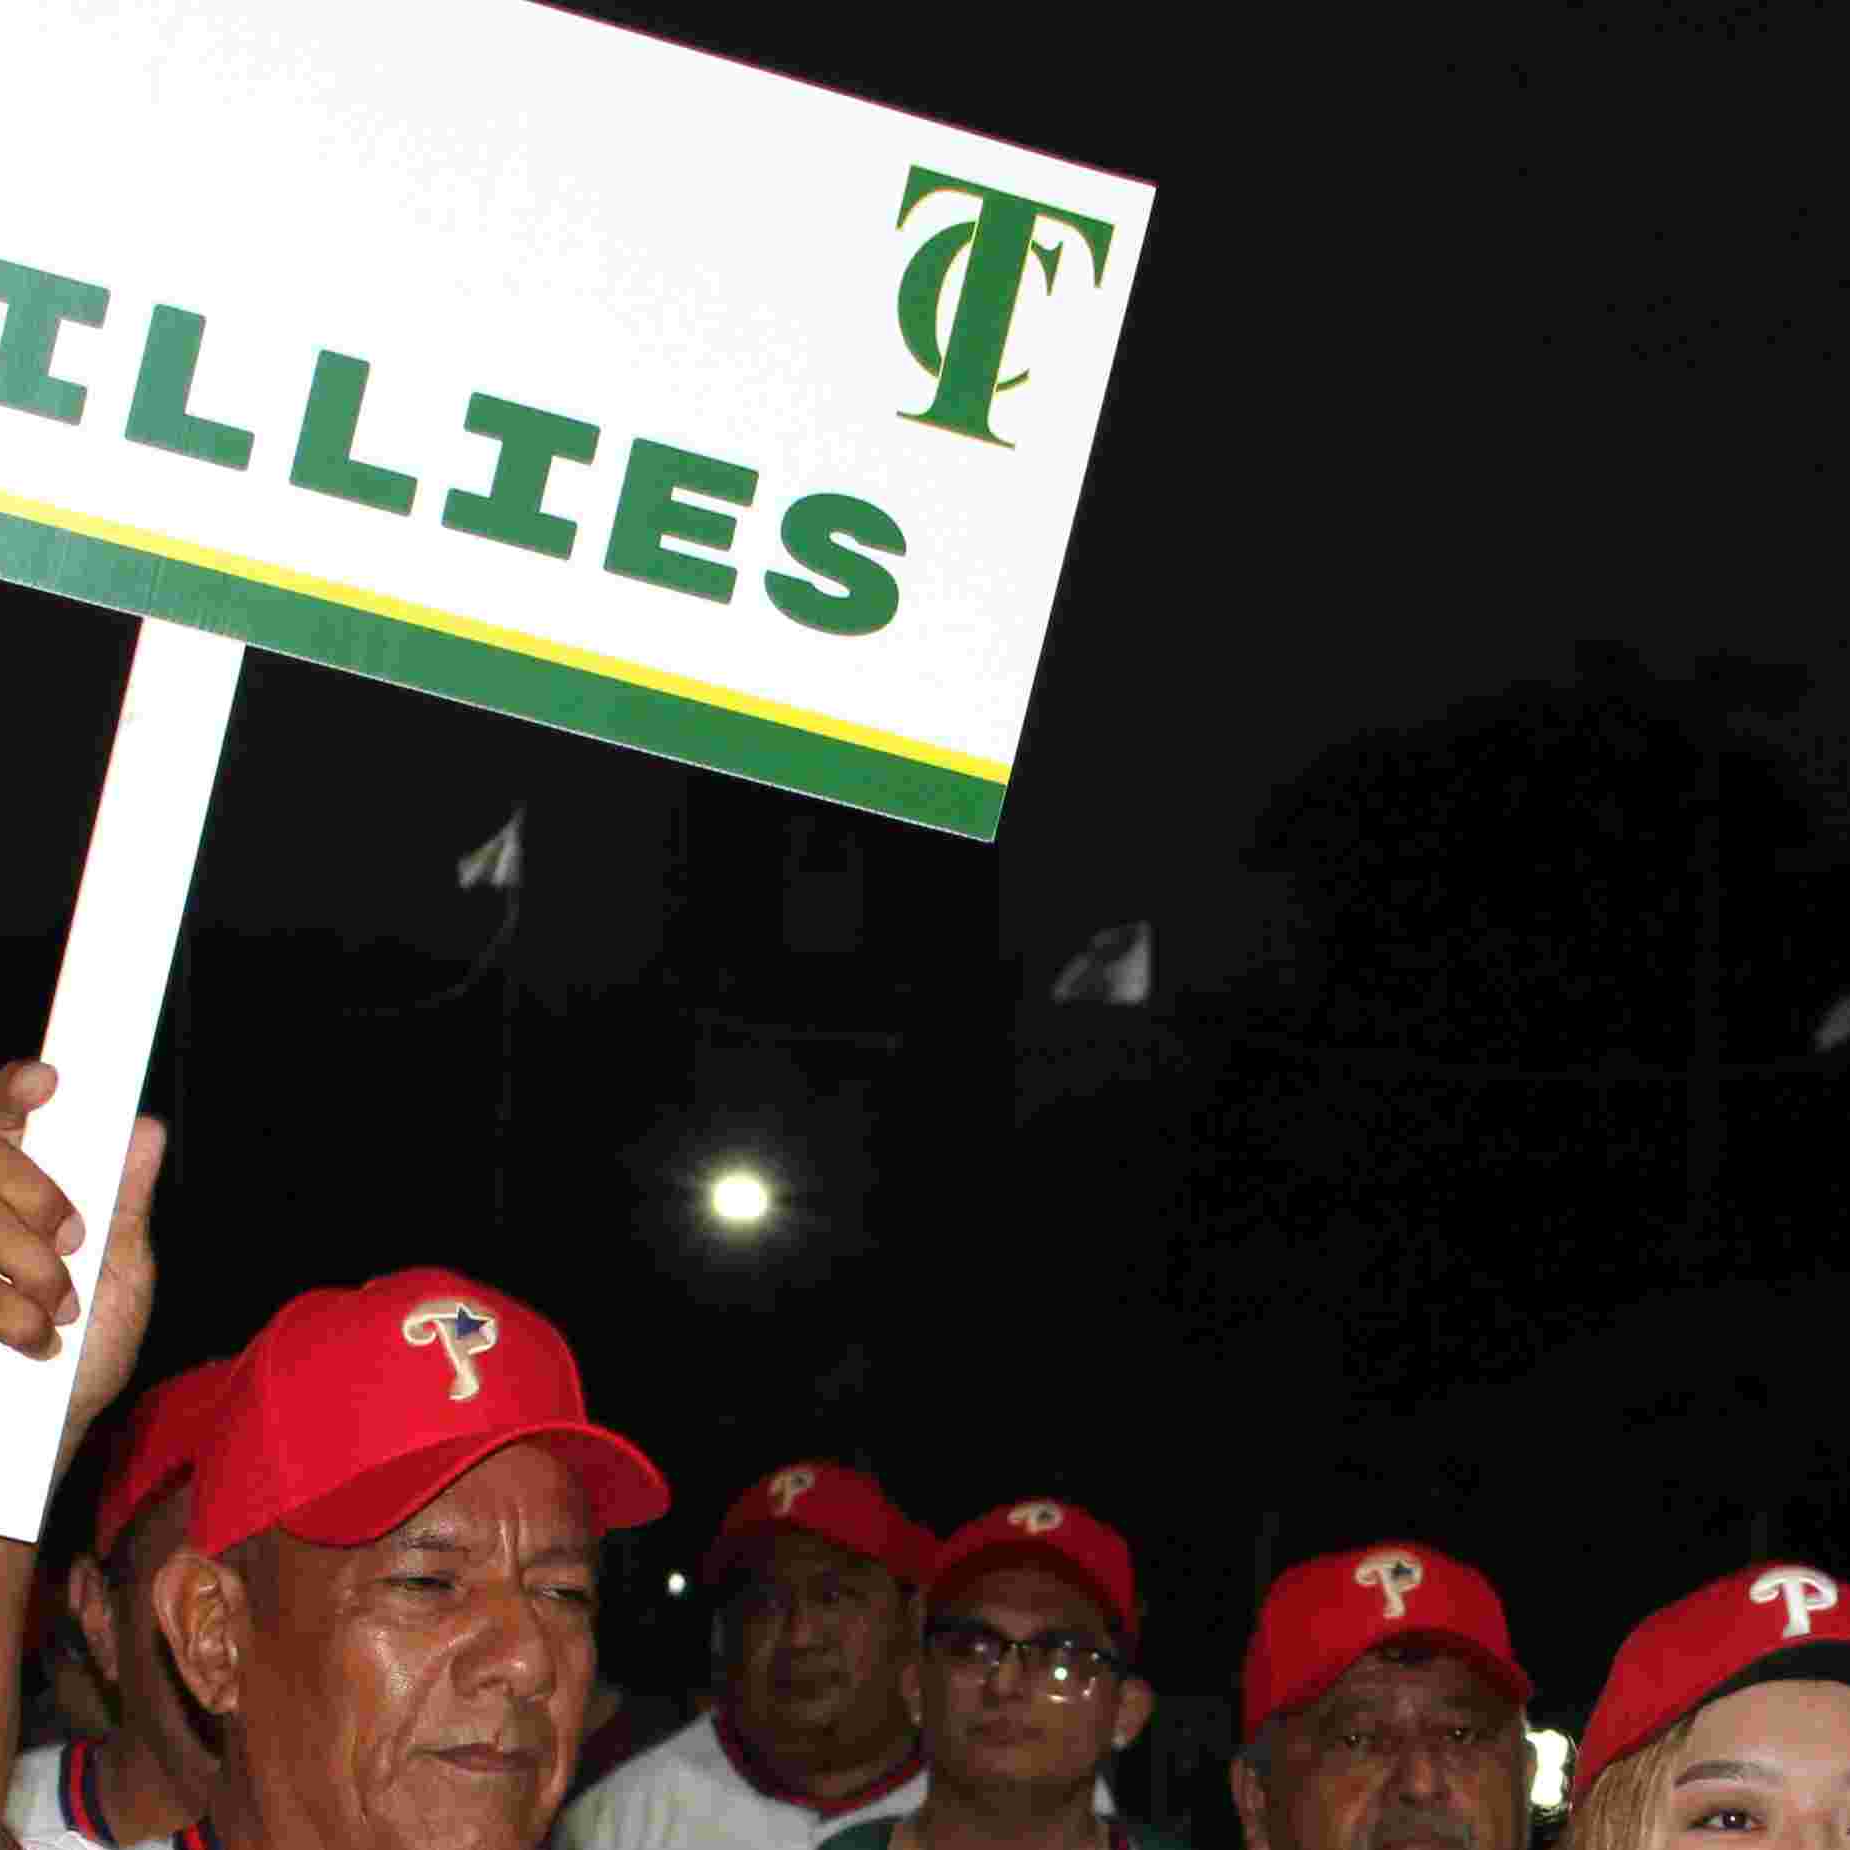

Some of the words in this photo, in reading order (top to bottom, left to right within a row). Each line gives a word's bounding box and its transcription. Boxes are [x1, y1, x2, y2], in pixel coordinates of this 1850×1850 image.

[402, 1299, 499, 1402] P
[1355, 1548, 1425, 1620] P
[1750, 1564, 1839, 1639] P
